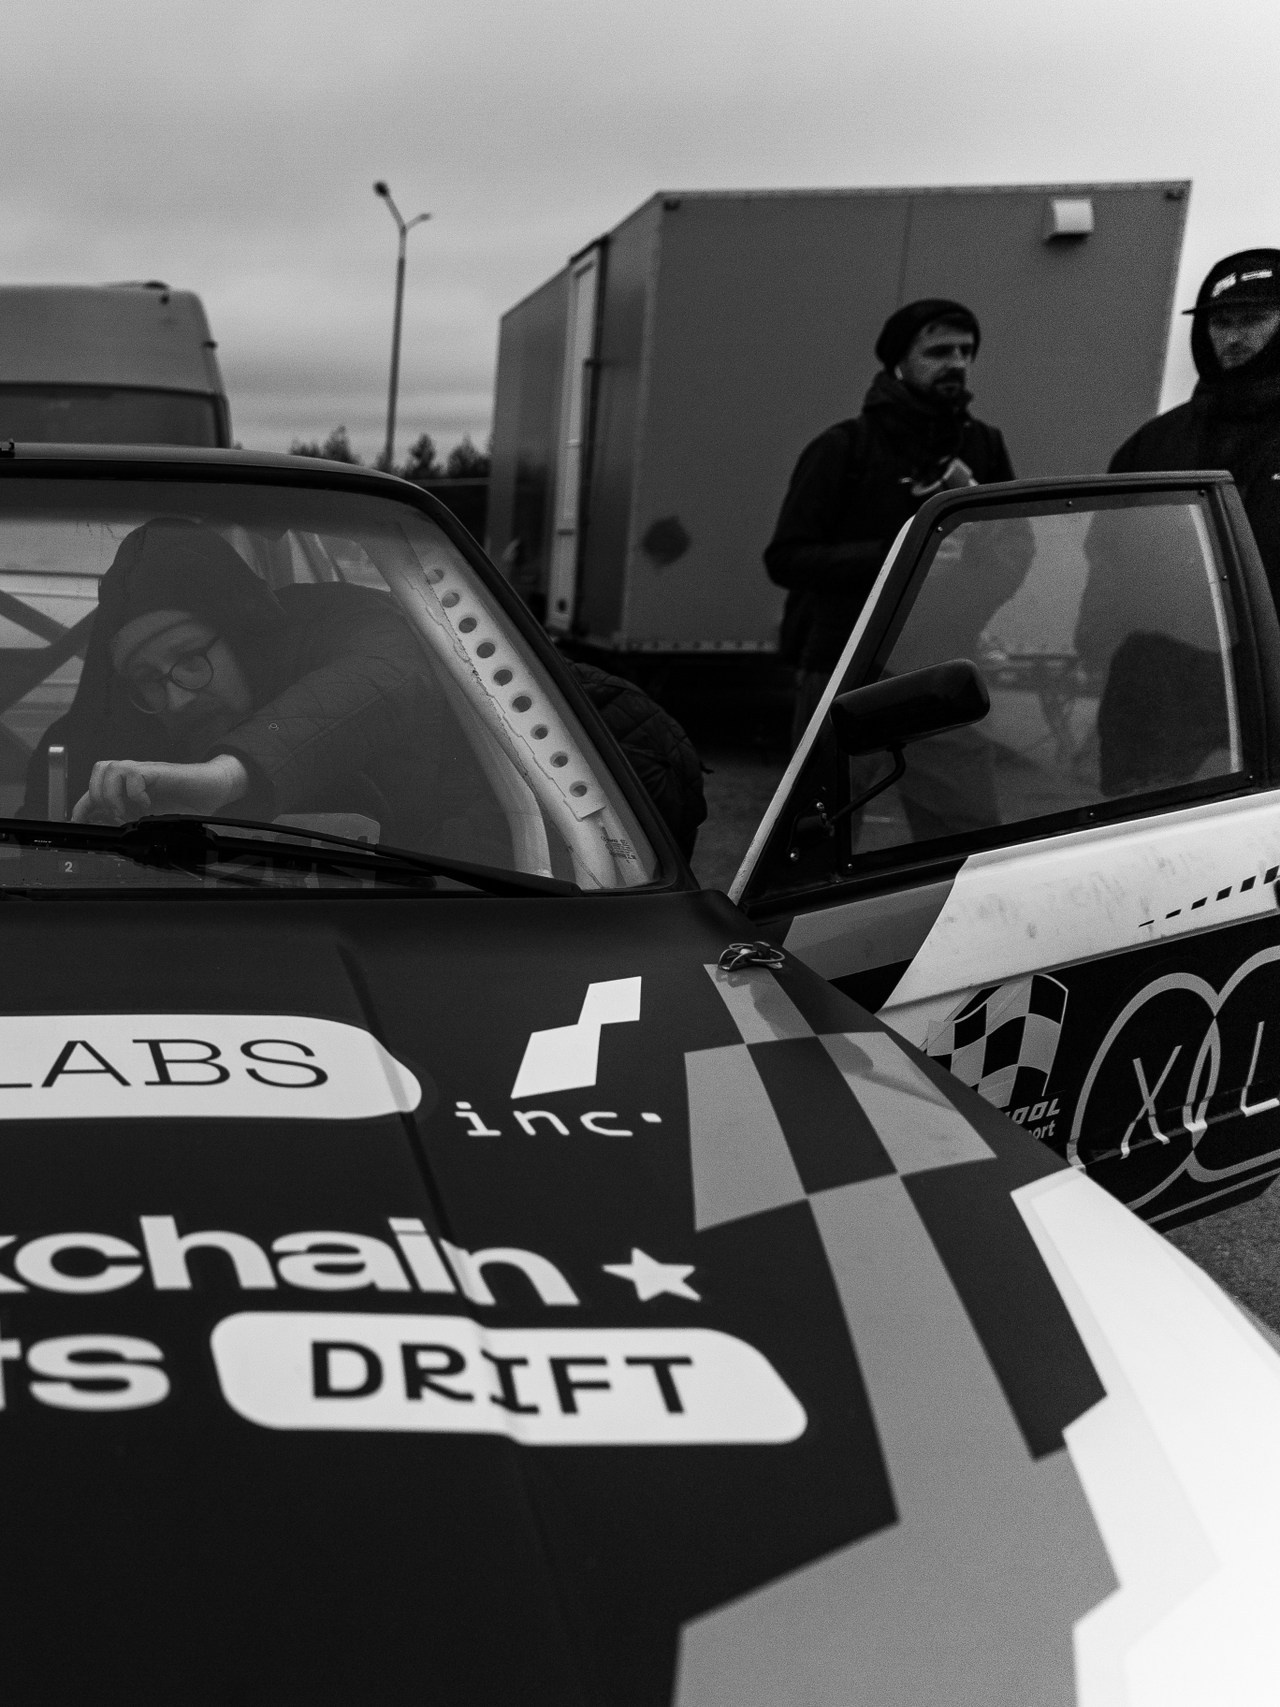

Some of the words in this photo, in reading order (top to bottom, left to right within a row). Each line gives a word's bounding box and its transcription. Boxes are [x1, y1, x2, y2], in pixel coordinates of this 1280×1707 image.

[64, 861, 73, 873] 2
[1005, 1097, 1061, 1125] OOL
[1120, 1044, 1184, 1160] X
[455, 1101, 662, 1137] inc.
[1028, 1119, 1056, 1140] ort
[311, 1341, 694, 1416] DRIFT
